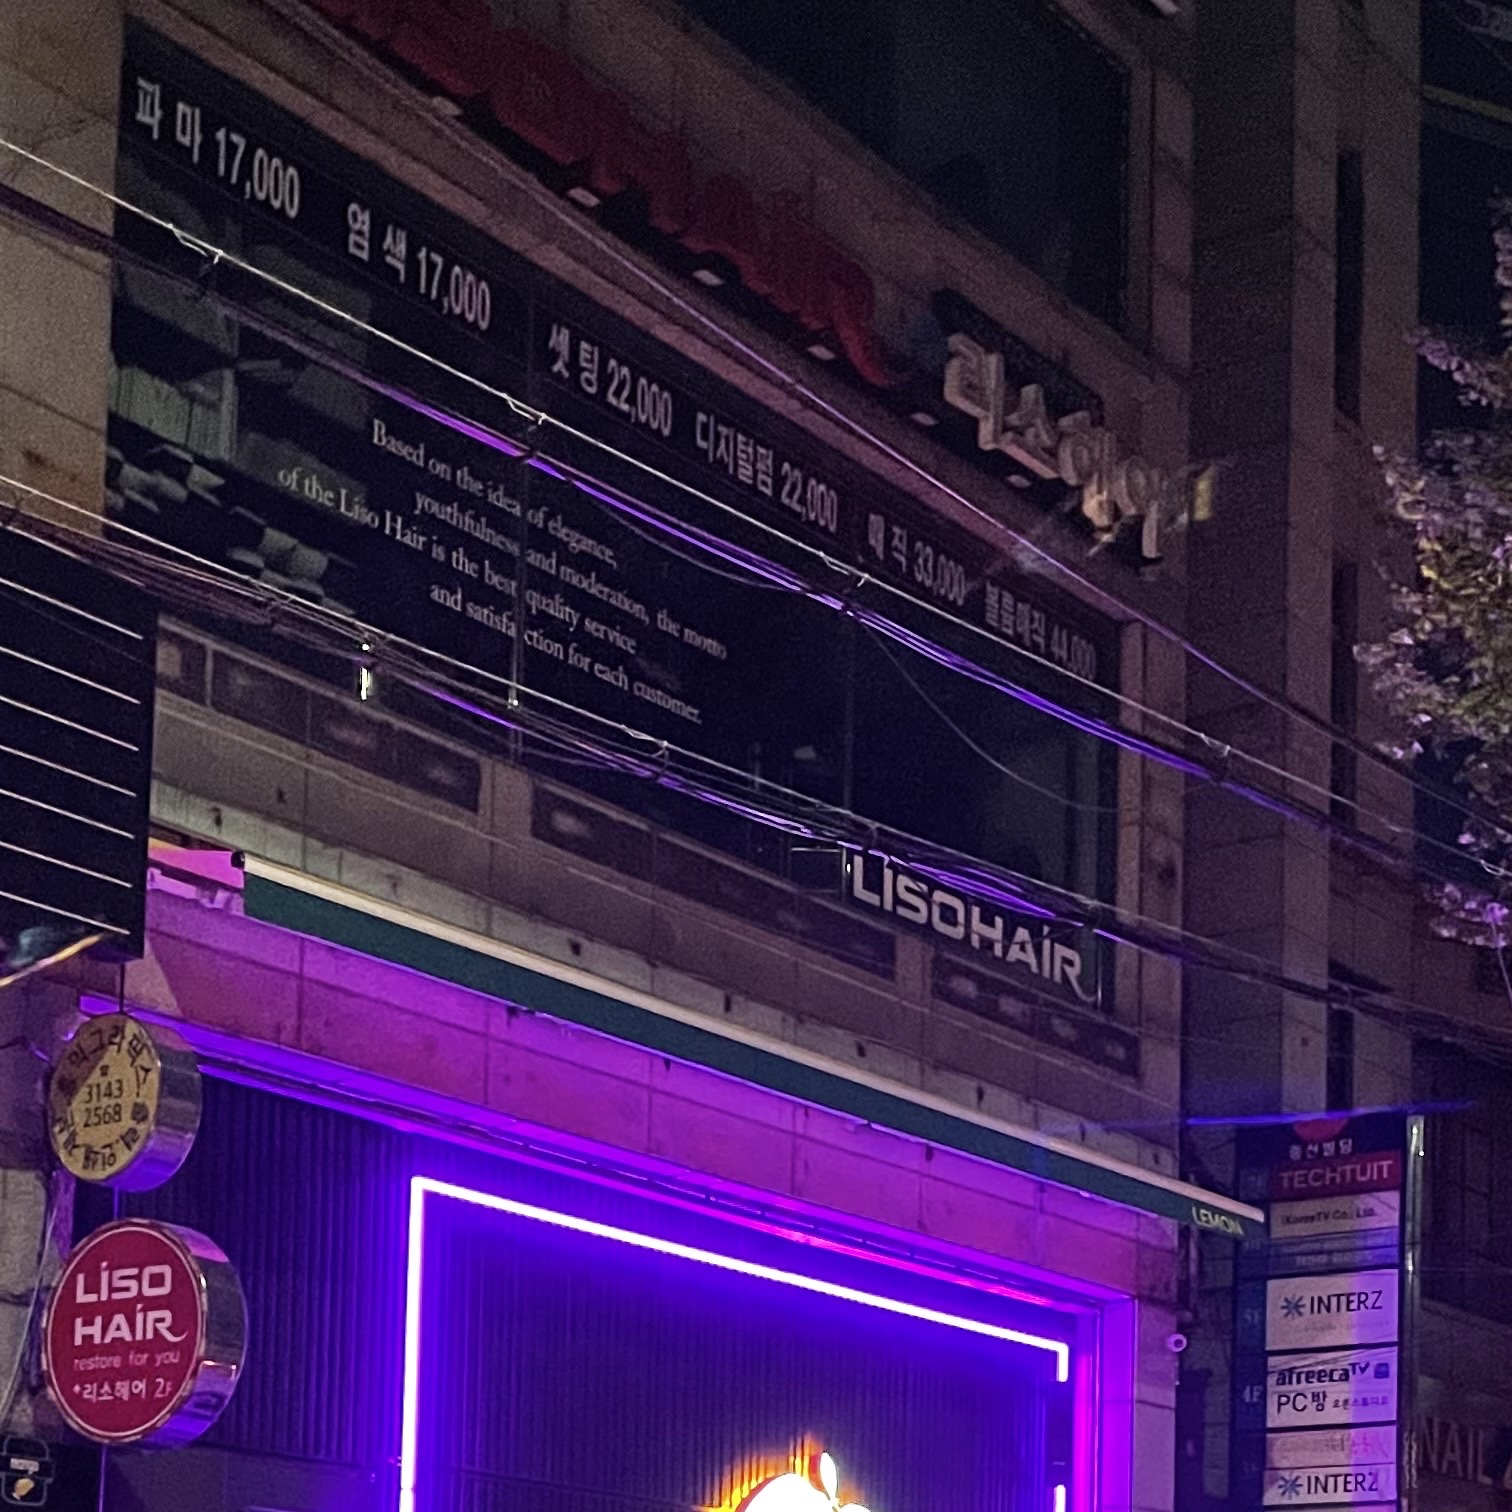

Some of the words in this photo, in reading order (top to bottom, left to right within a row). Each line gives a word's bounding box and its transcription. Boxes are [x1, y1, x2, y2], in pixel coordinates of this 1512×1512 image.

[216, 127, 300, 219] 17,000
[417, 246, 491, 331] 17,000
[606, 358, 672, 437] 22,000
[372, 419, 424, 467] Based
[428, 455, 452, 478] on
[456, 467, 482, 497] the
[487, 480, 521, 517] idea
[527, 506, 547, 529] of
[548, 513, 618, 568] elegance,
[781, 461, 837, 533] 22,000
[278, 467, 300, 490] of
[303, 477, 334, 507] the
[339, 487, 379, 529] Liso
[384, 510, 427, 551] Hair
[431, 535, 446, 561] is
[451, 545, 478, 577] the
[483, 560, 518, 598] best
[525, 587, 580, 631] quality
[584, 615, 637, 655] service
[414, 491, 520, 555] youthfulness
[527, 546, 556, 575] and
[560, 562, 650, 625] moderation,
[656, 609, 680, 635] the
[683, 627, 727, 660] motto
[430, 583, 463, 613] and
[567, 645, 592, 673] for
[594, 658, 628, 690] each
[84, 1079, 123, 1104] 3143
[83, 1103, 122, 1128] 2568
[1279, 1160, 1394, 1189] TECHTUIT
[1192, 1206, 1244, 1236] LEMON
[76, 1262, 173, 1304] LISO
[1310, 1290, 1383, 1315] INTERZ
[74, 1304, 189, 1346] HAIR
[74, 1354, 122, 1371] restore
[129, 1352, 148, 1366] for
[155, 1351, 180, 1367] you
[82, 1379, 147, 1403] 리소헤어
[1242, 1385, 1263, 1402] 4F
[1277, 1391, 1328, 1413] PC방
[1419, 1417, 1492, 1485] NAIL
[1306, 1472, 1379, 1495] INTERZ
